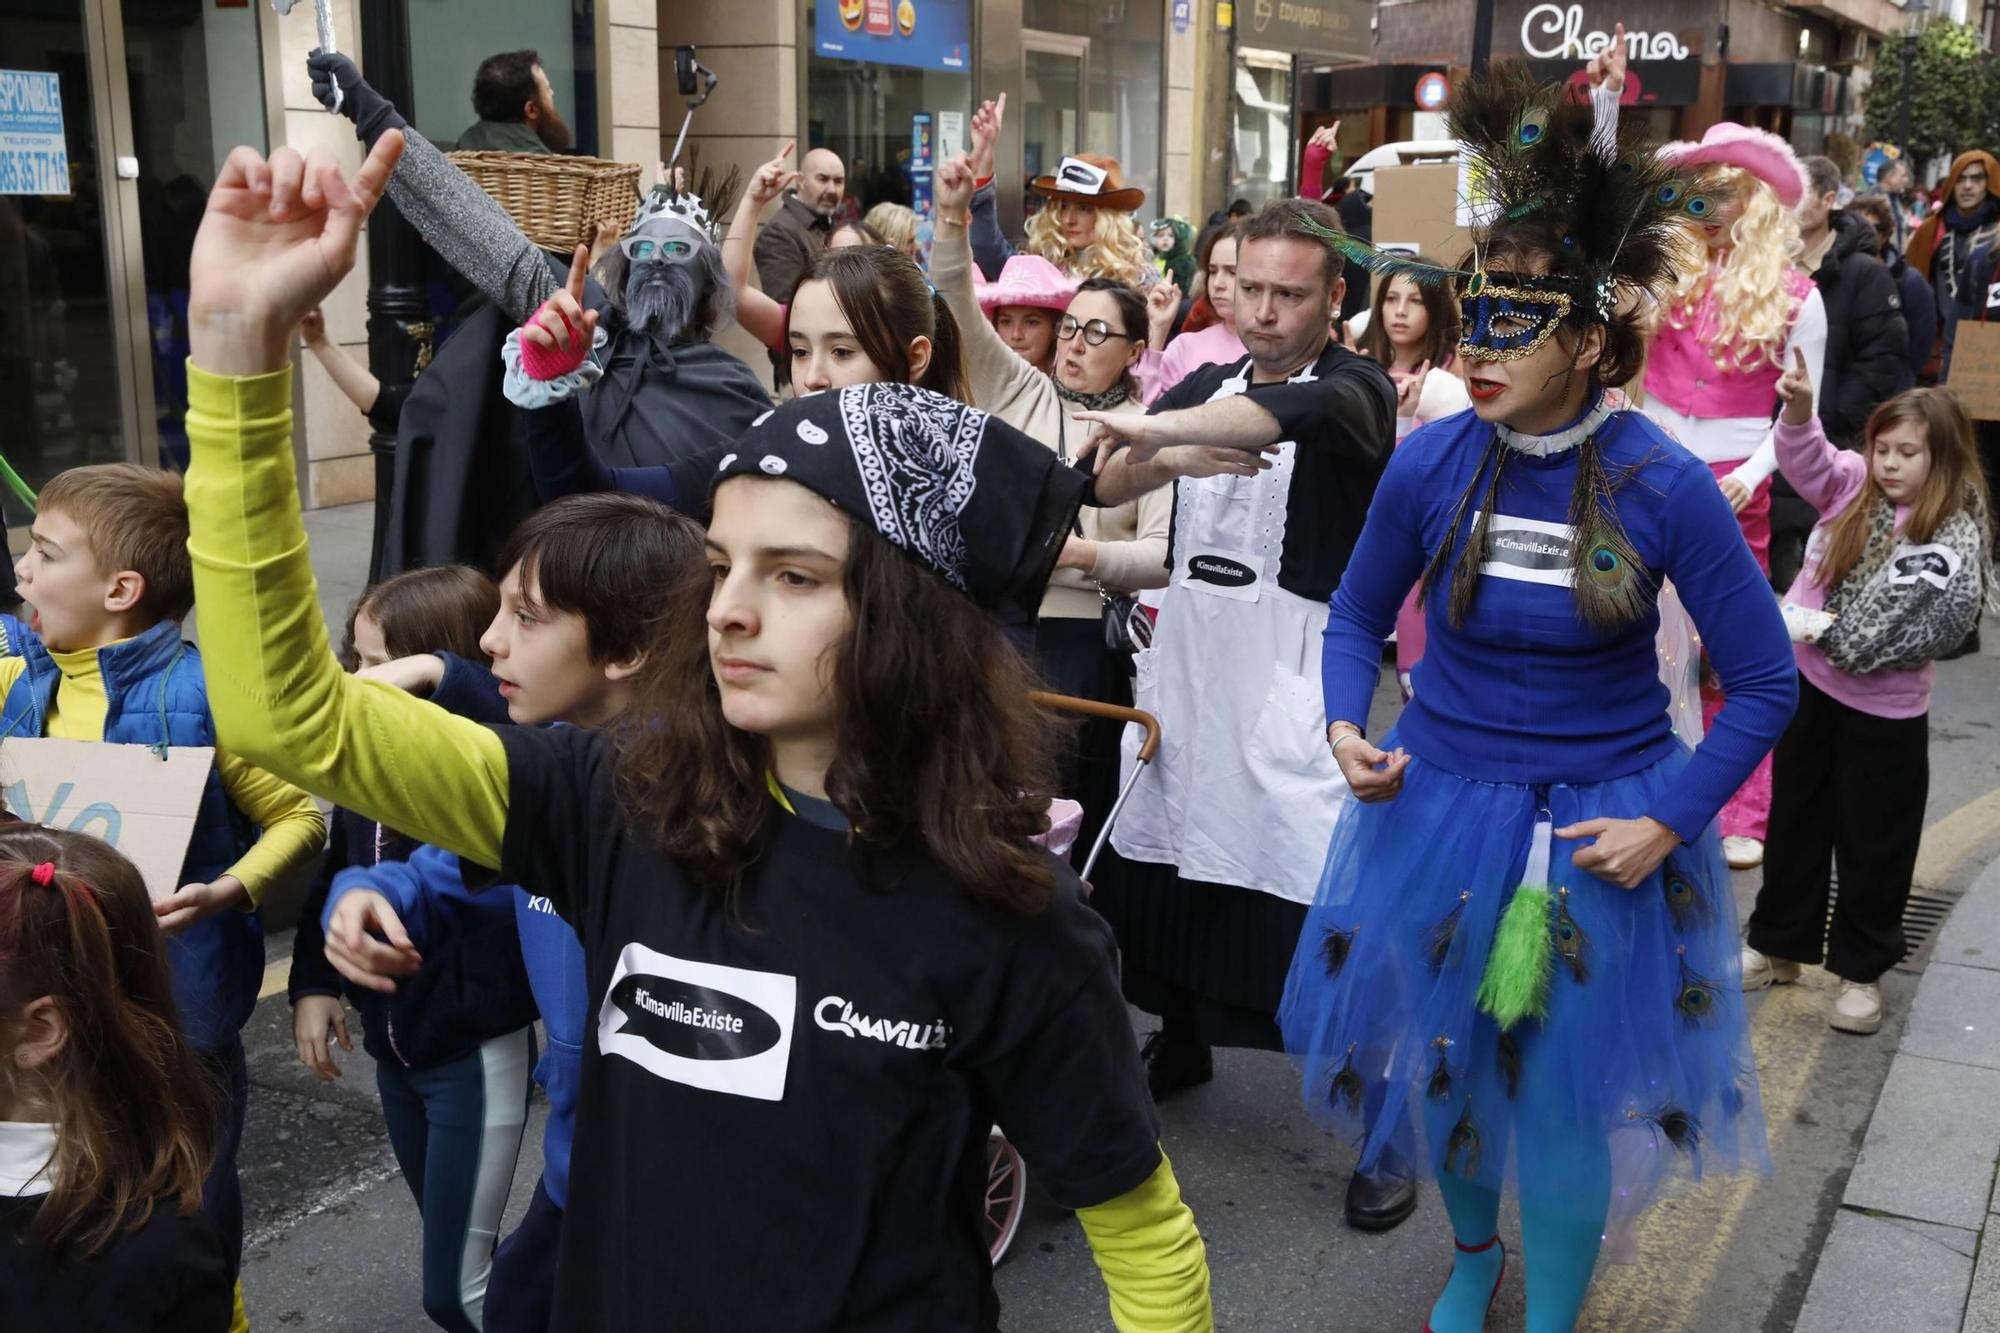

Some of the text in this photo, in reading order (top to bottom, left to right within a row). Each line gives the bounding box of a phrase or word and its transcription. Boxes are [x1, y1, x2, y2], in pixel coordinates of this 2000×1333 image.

[1495, 537, 1570, 558] #CimavillaExiste
[1196, 560, 1243, 577] #CimavillaExiste
[635, 987, 743, 1033] #CimavillaExiste
